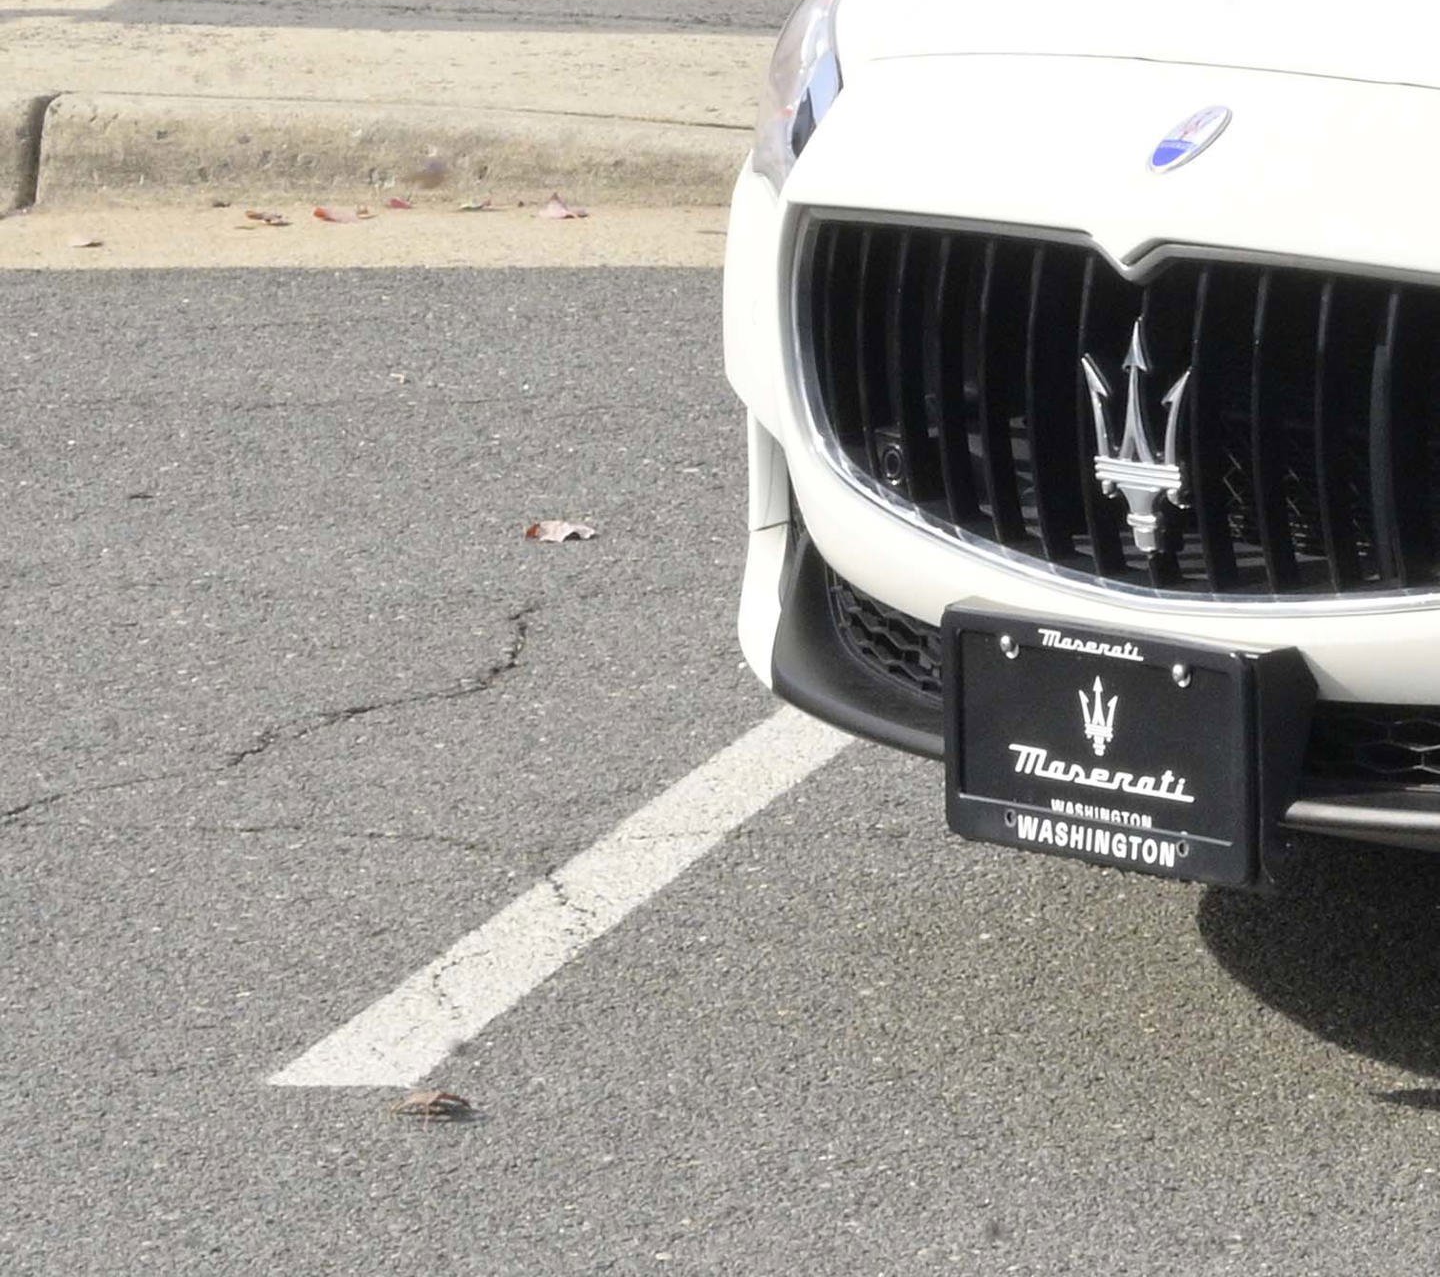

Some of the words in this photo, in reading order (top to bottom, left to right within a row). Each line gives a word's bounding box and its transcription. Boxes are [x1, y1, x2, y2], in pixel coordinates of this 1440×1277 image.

[1038, 628, 1144, 662] Maserati
[1009, 743, 1195, 803] Maserati
[1051, 798, 1152, 828] WASHINGTON
[1017, 814, 1176, 867] WASHINGTON
